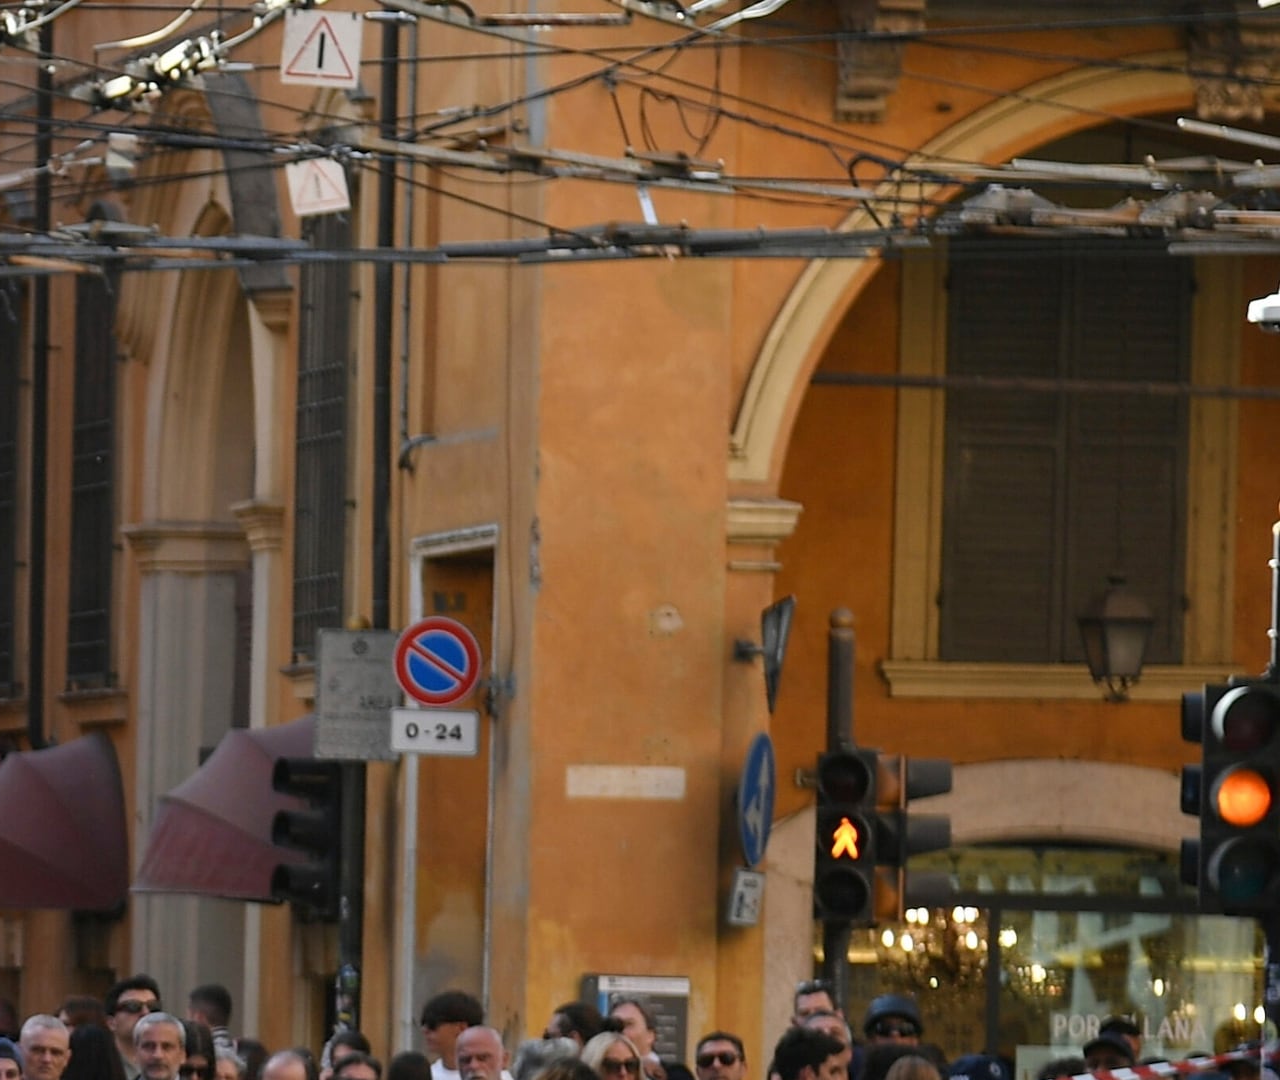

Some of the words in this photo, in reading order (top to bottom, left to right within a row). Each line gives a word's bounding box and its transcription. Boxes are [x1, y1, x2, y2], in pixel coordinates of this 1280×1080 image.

[406, 722, 419, 739] 0
[435, 723, 462, 740] 24
[1054, 1013, 1206, 1040] PORLANA
